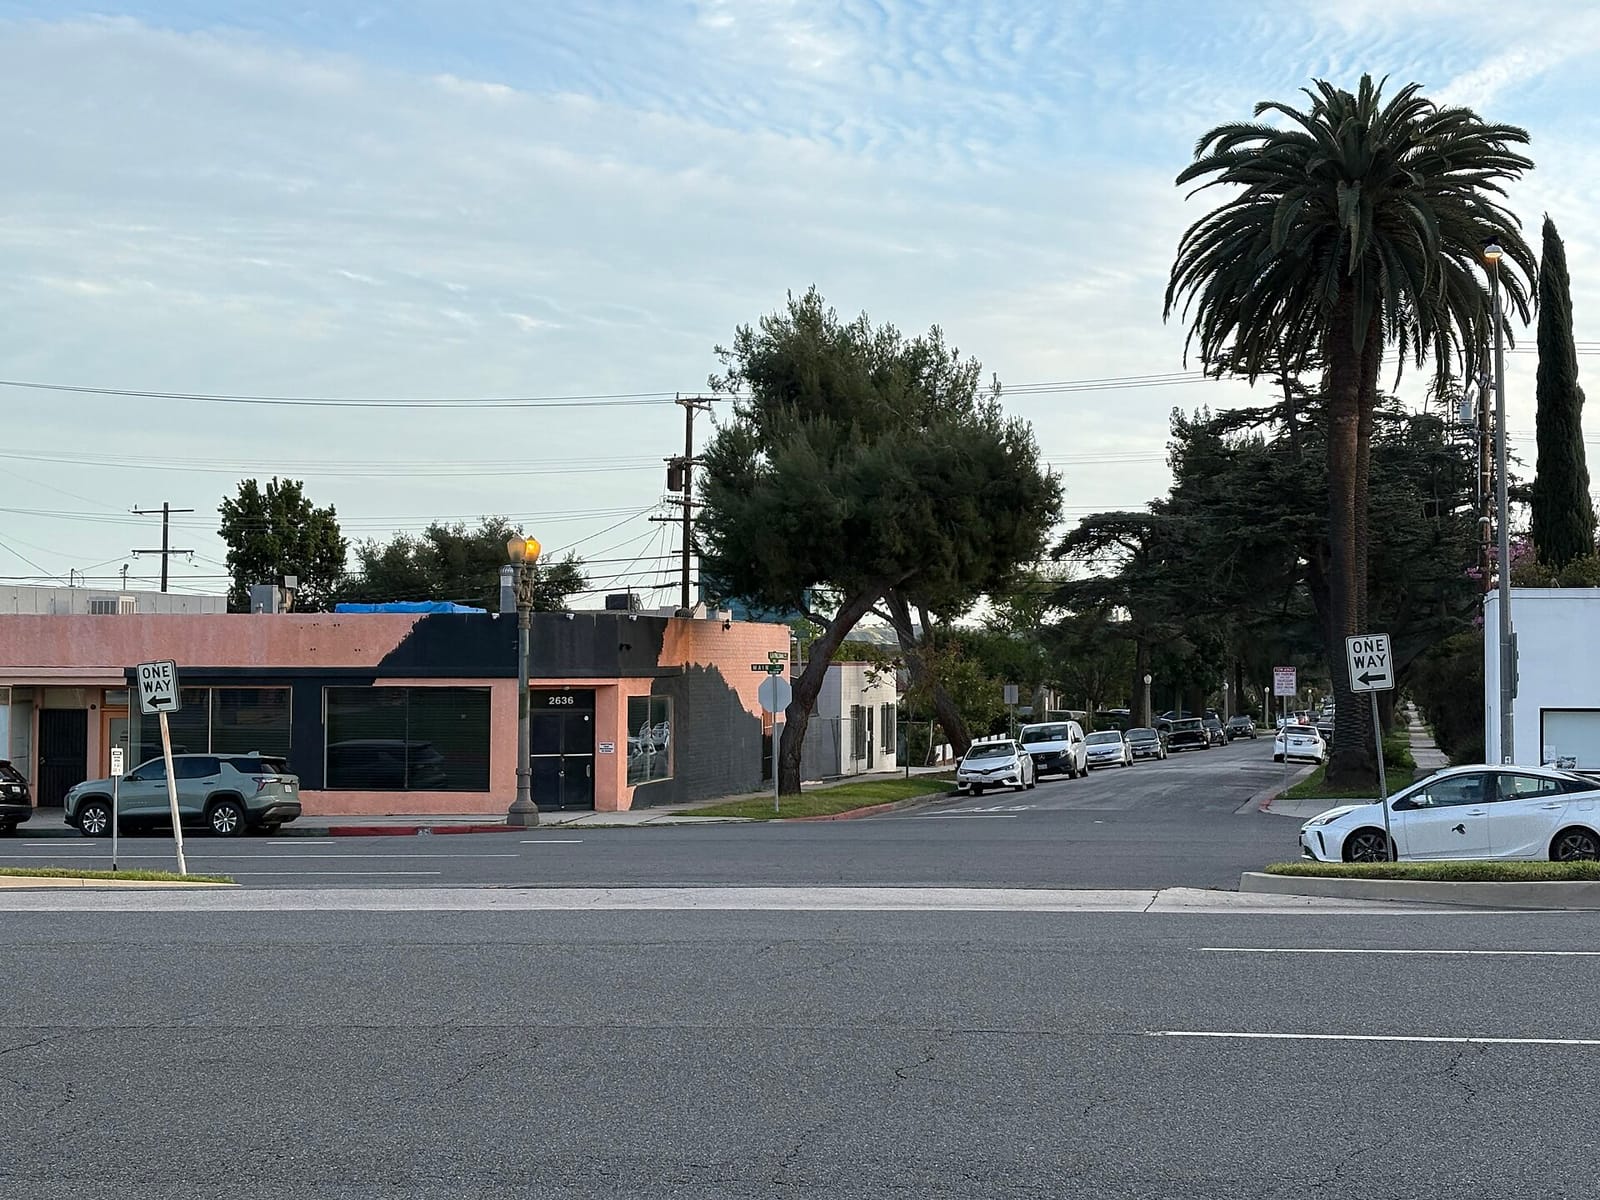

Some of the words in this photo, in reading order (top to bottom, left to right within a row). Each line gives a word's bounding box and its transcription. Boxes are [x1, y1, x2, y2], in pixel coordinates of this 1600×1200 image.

[1353, 639, 1385, 653] ONE
[1353, 654, 1386, 669] WAY
[142, 665, 170, 679] ONE
[143, 680, 170, 693] WAY
[548, 696, 574, 705] 2636
